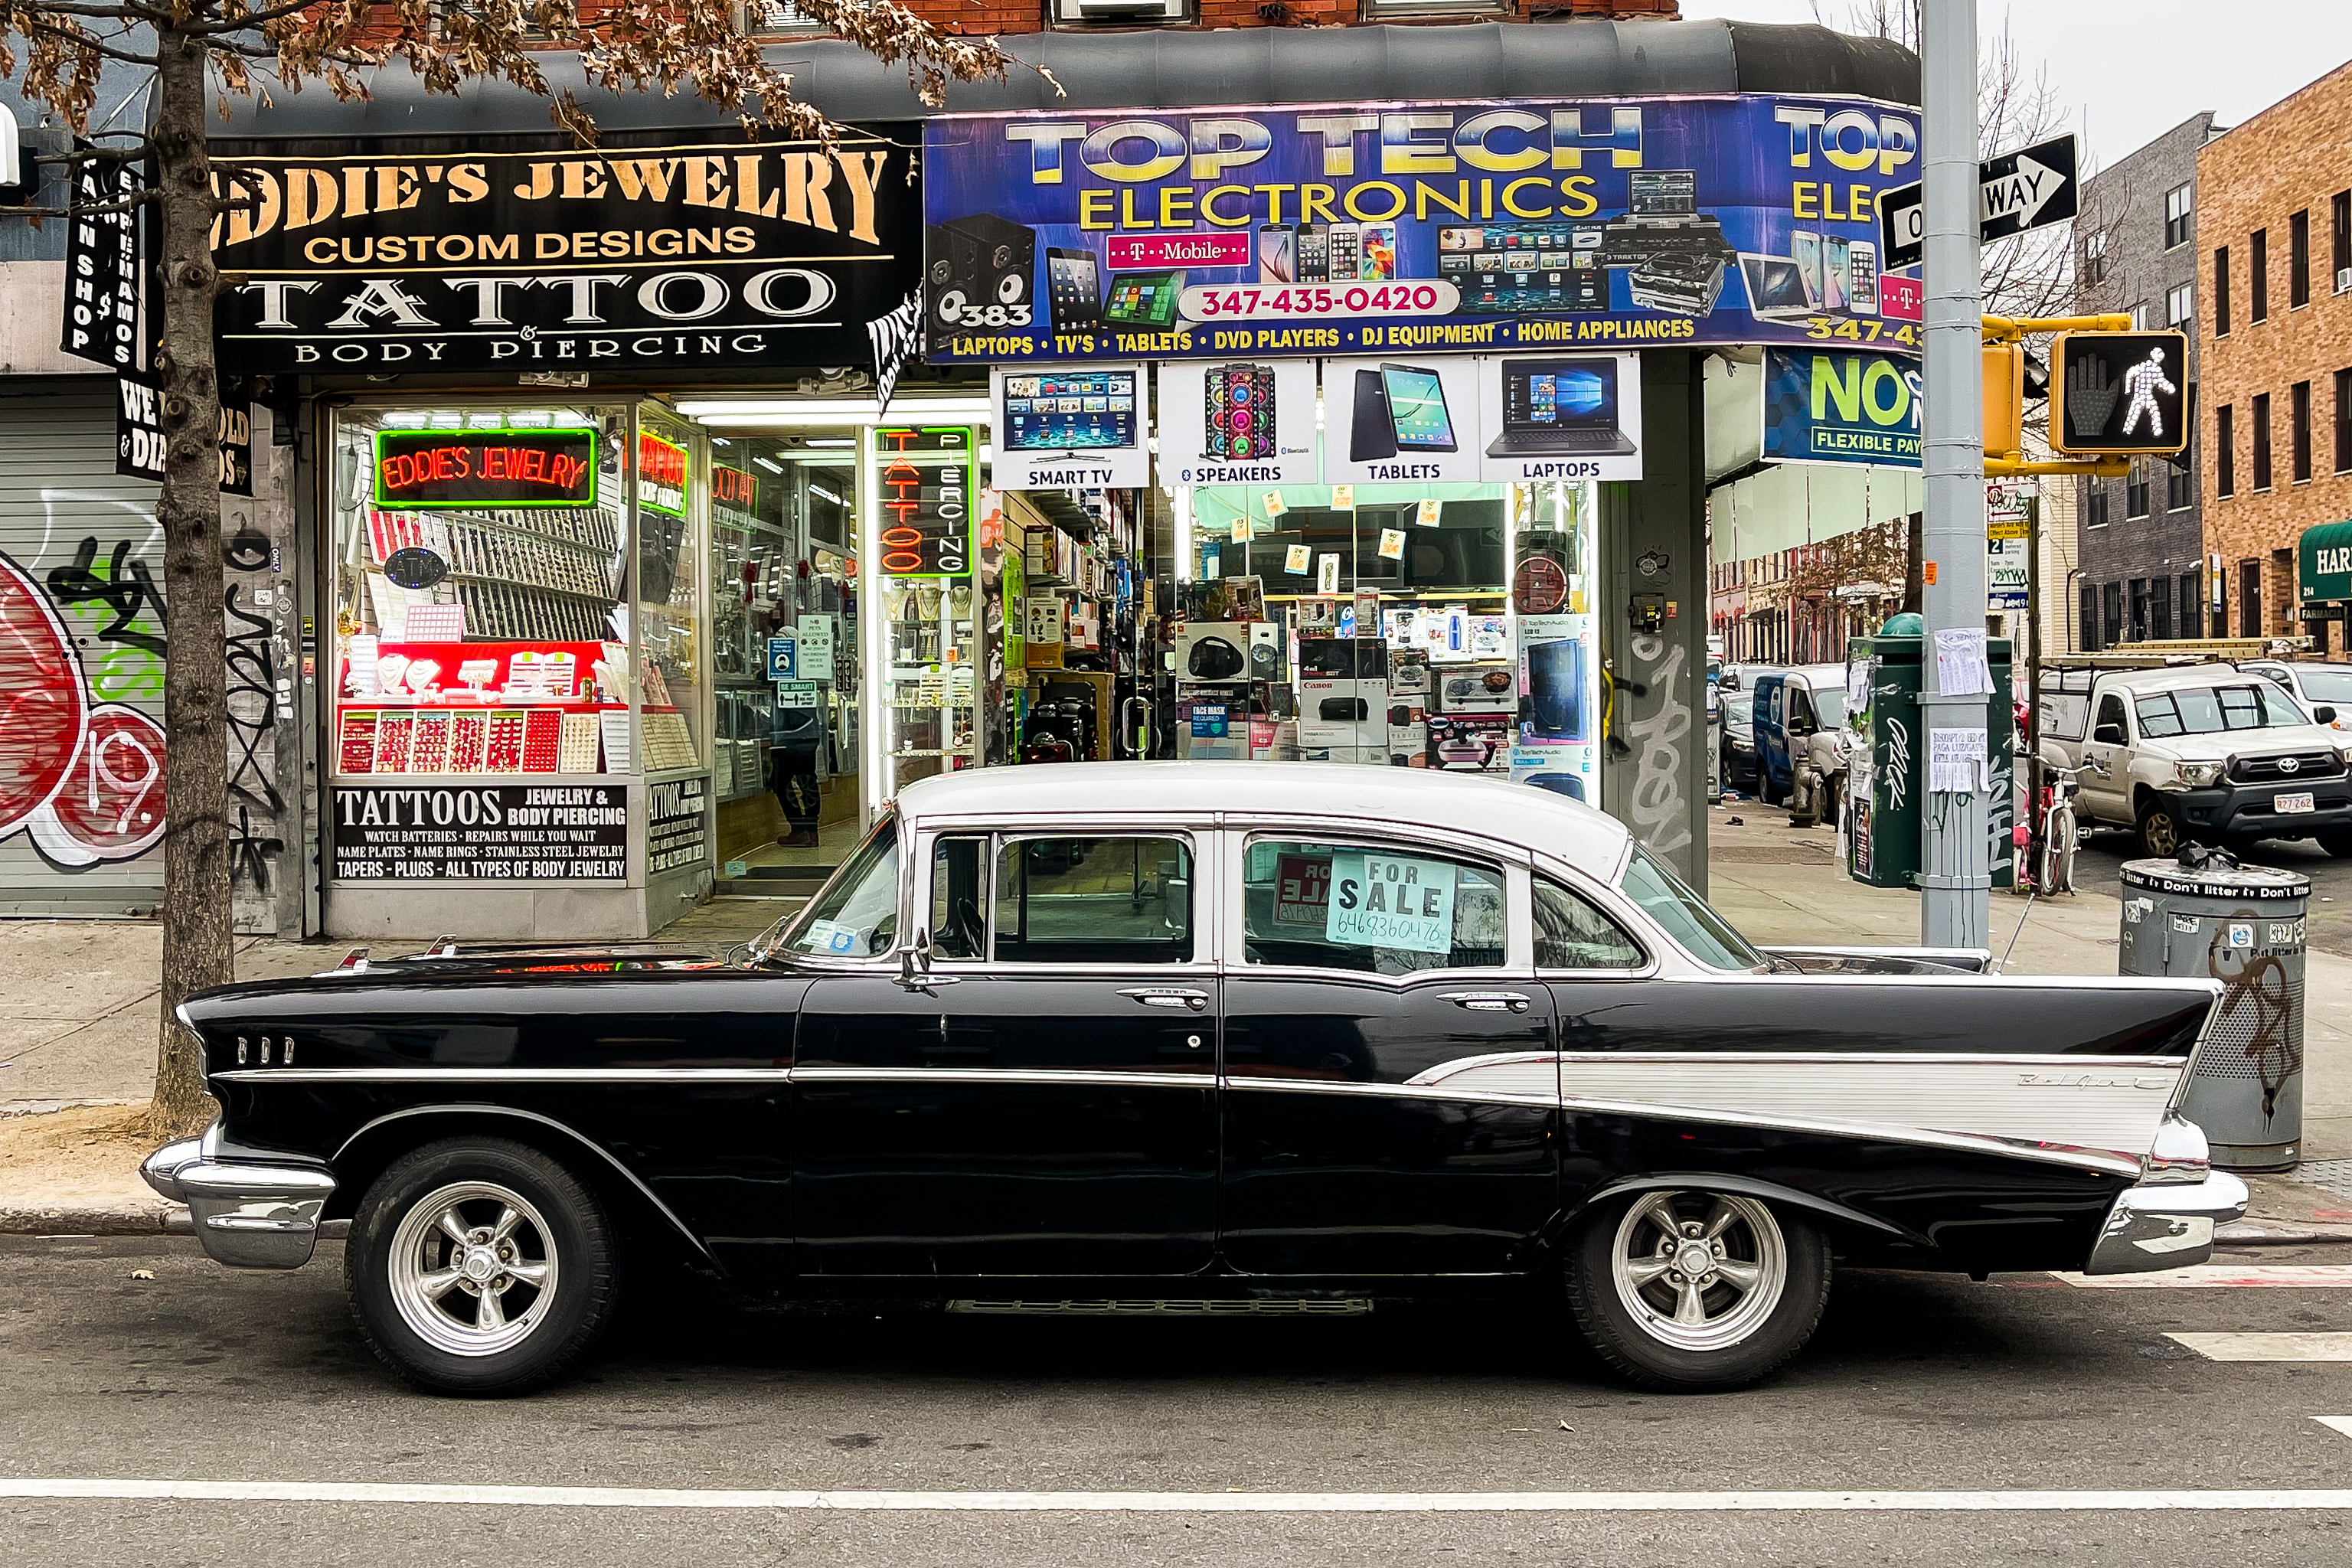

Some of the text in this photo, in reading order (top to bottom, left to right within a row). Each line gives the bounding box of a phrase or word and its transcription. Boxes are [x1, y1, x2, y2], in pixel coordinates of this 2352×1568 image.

[1007, 106, 1643, 185] TOP TECH
[1775, 105, 1917, 175] TOP
[514, 149, 888, 246] JEWELRY
[1080, 175, 1600, 231] ELECTRONICS
[1985, 169, 2044, 216] WAY
[304, 226, 756, 263] CUSTOM DESIGNS
[1164, 236, 1223, 261] Mobile
[72, 254, 93, 349] SHOP
[234, 268, 837, 330] TATTOO
[1202, 285, 1438, 316] 347-435-0420
[959, 304, 1033, 328] 383
[520, 325, 537, 341] &
[952, 318, 1694, 355] LAPTOPS TV'S TABLETS DVD PLAYERS DJ EQUIPMENT HOME APPLIANCES
[296, 333, 767, 364] BODY PIERCING
[120, 379, 157, 426] WE
[1811, 354, 1910, 426] NO
[120, 434, 130, 457] &
[1817, 432, 1922, 454] FLEXIBLE PAY
[381, 446, 588, 490] EDDIE'S JEWELRY
[1029, 469, 1113, 485] SMART TV
[1196, 466, 1282, 482] SPEAKERS
[1367, 464, 1441, 481] TABLETS
[1522, 462, 1601, 479] LAPTOPS
[880, 432, 923, 572] TATTOO
[937, 434, 964, 572] PIERCING
[1991, 539, 2001, 553] 2
[2301, 609, 2342, 619] FARMACIA
[1193, 706, 1225, 715] FACE MASK
[337, 789, 501, 826] TATTOOS
[525, 788, 608, 805] JEWELRY &
[648, 782, 681, 820] ATTOOS
[2295, 798, 2311, 808] 262
[508, 807, 626, 826] BODY PIERCING
[364, 830, 596, 843] WATCH BATTERIES REPAIRS WHILE YOU WAIT
[337, 845, 624, 858] NAME PLATES NAME RINGS STAINLESS STEEL JEWELRY
[336, 861, 625, 878] TAPERS PLUGS ALL TYPES OF BODY JEWELRY
[1369, 861, 1419, 885] FOR
[2126, 870, 2310, 898] litter Don't litter Don't litter
[1338, 878, 1442, 919] SALE
[1338, 910, 1441, 942] 6468360476
[2272, 946, 2292, 957] litter
